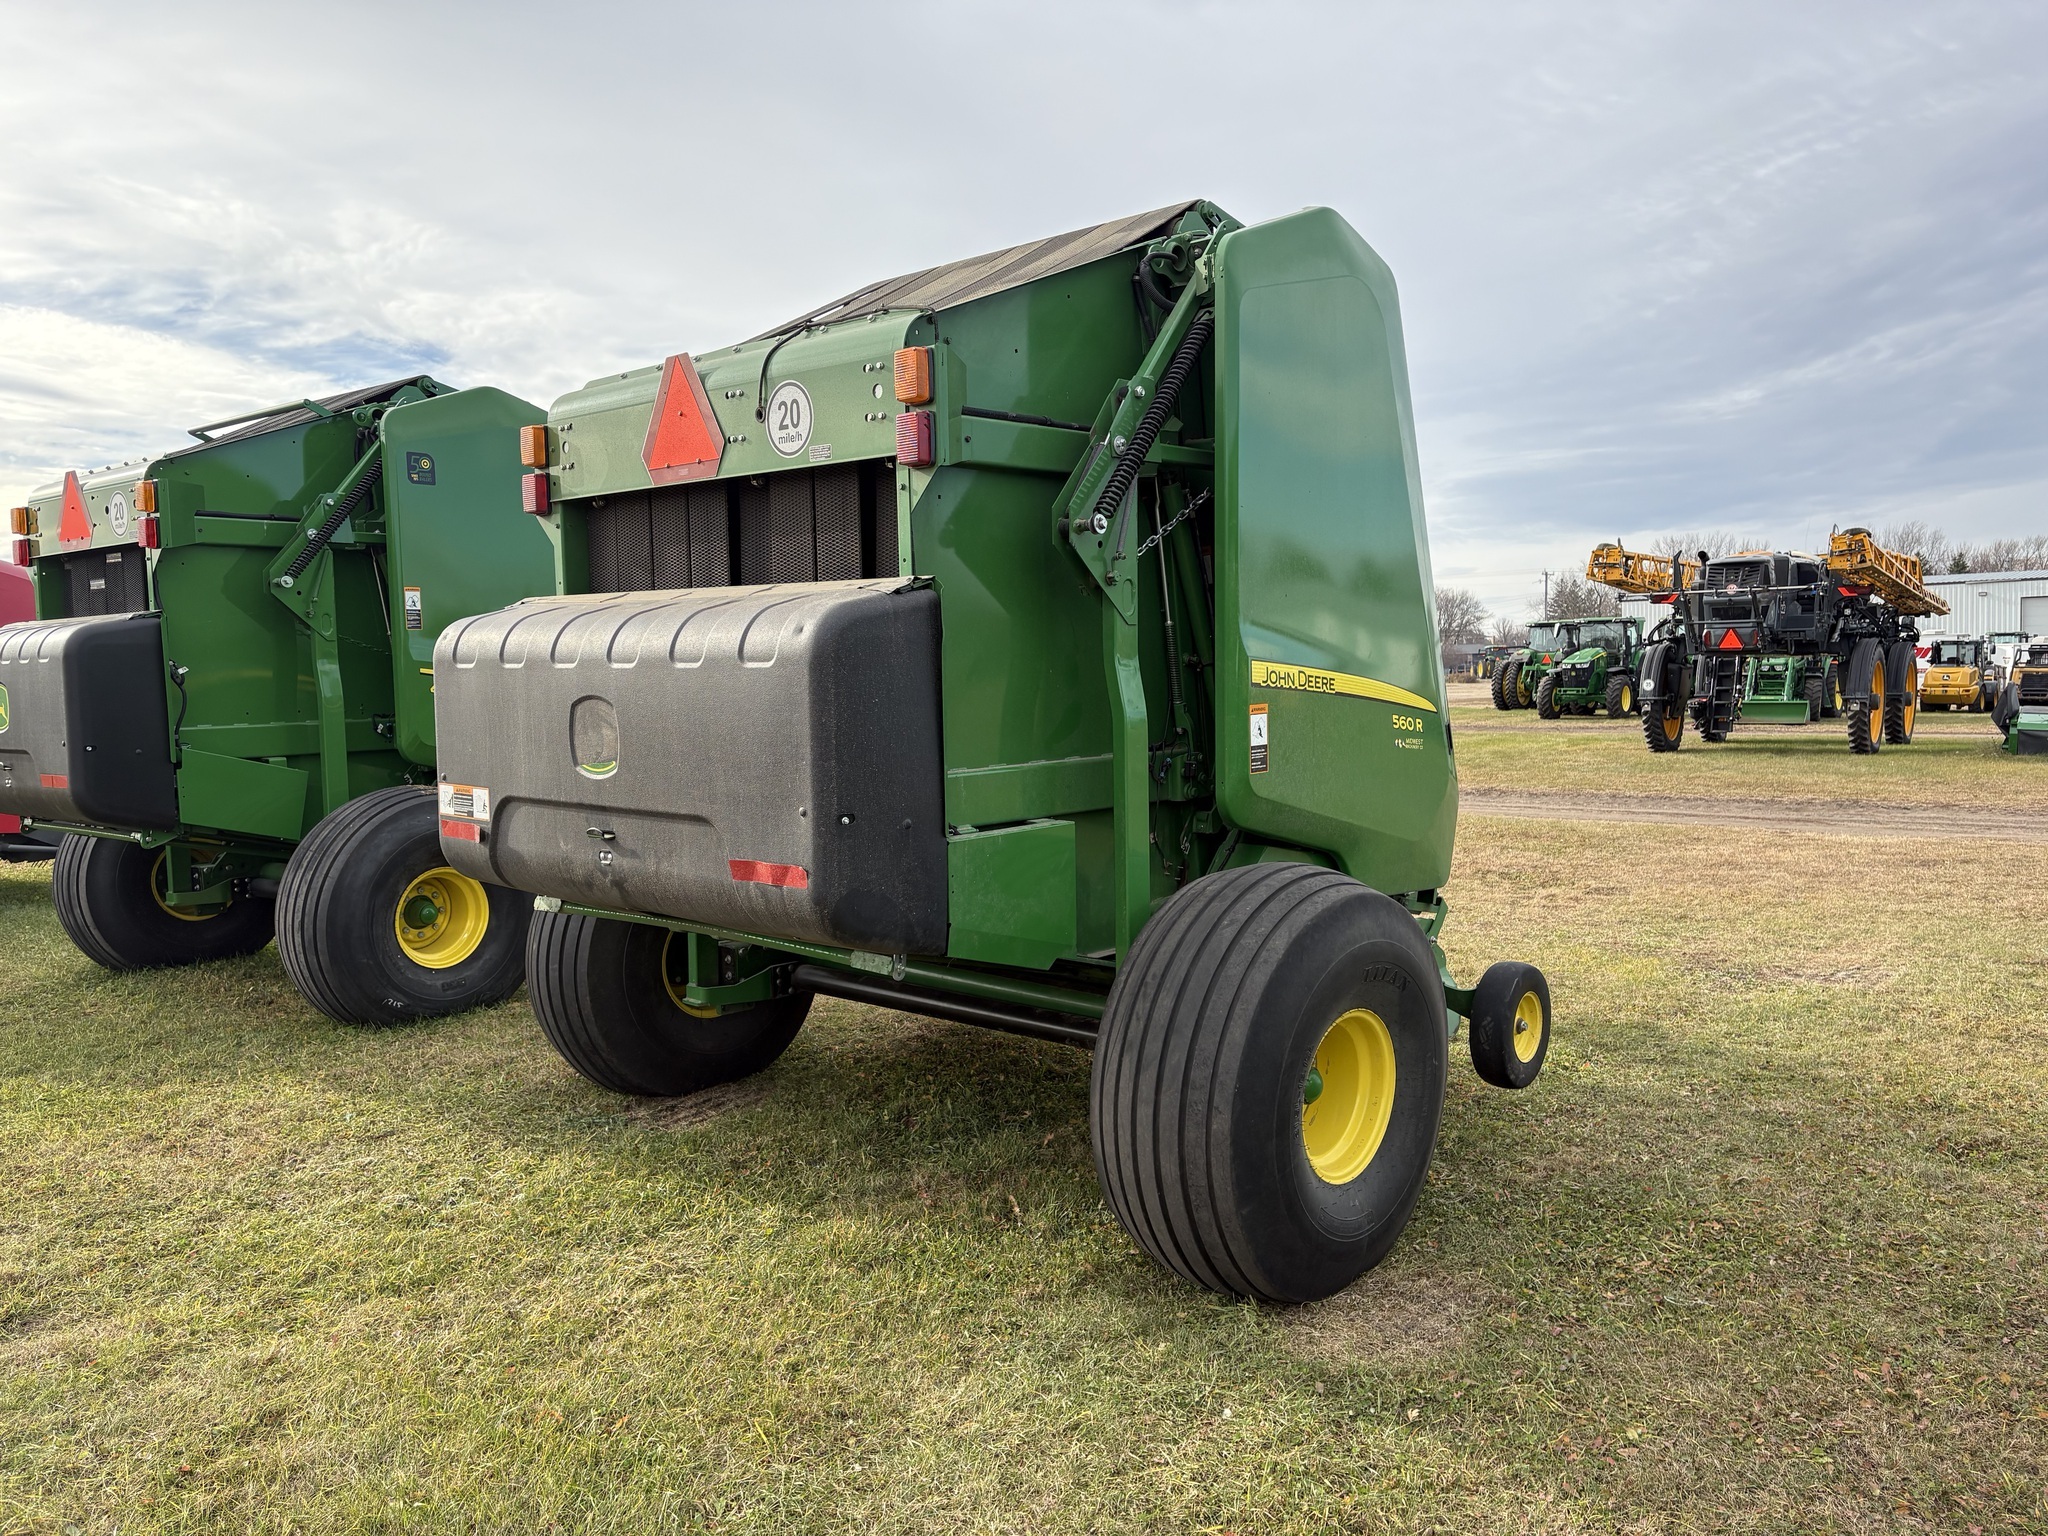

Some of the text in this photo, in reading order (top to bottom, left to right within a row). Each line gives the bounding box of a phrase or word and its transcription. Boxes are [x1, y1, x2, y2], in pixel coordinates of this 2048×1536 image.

[778, 398, 801, 431] 20
[778, 431, 803, 444] mile/h
[113, 502, 125, 521] 20
[1261, 666, 1336, 691] JOHN DEERE
[1392, 714, 1424, 732] 560 R
[1361, 965, 1411, 992] TITAN
